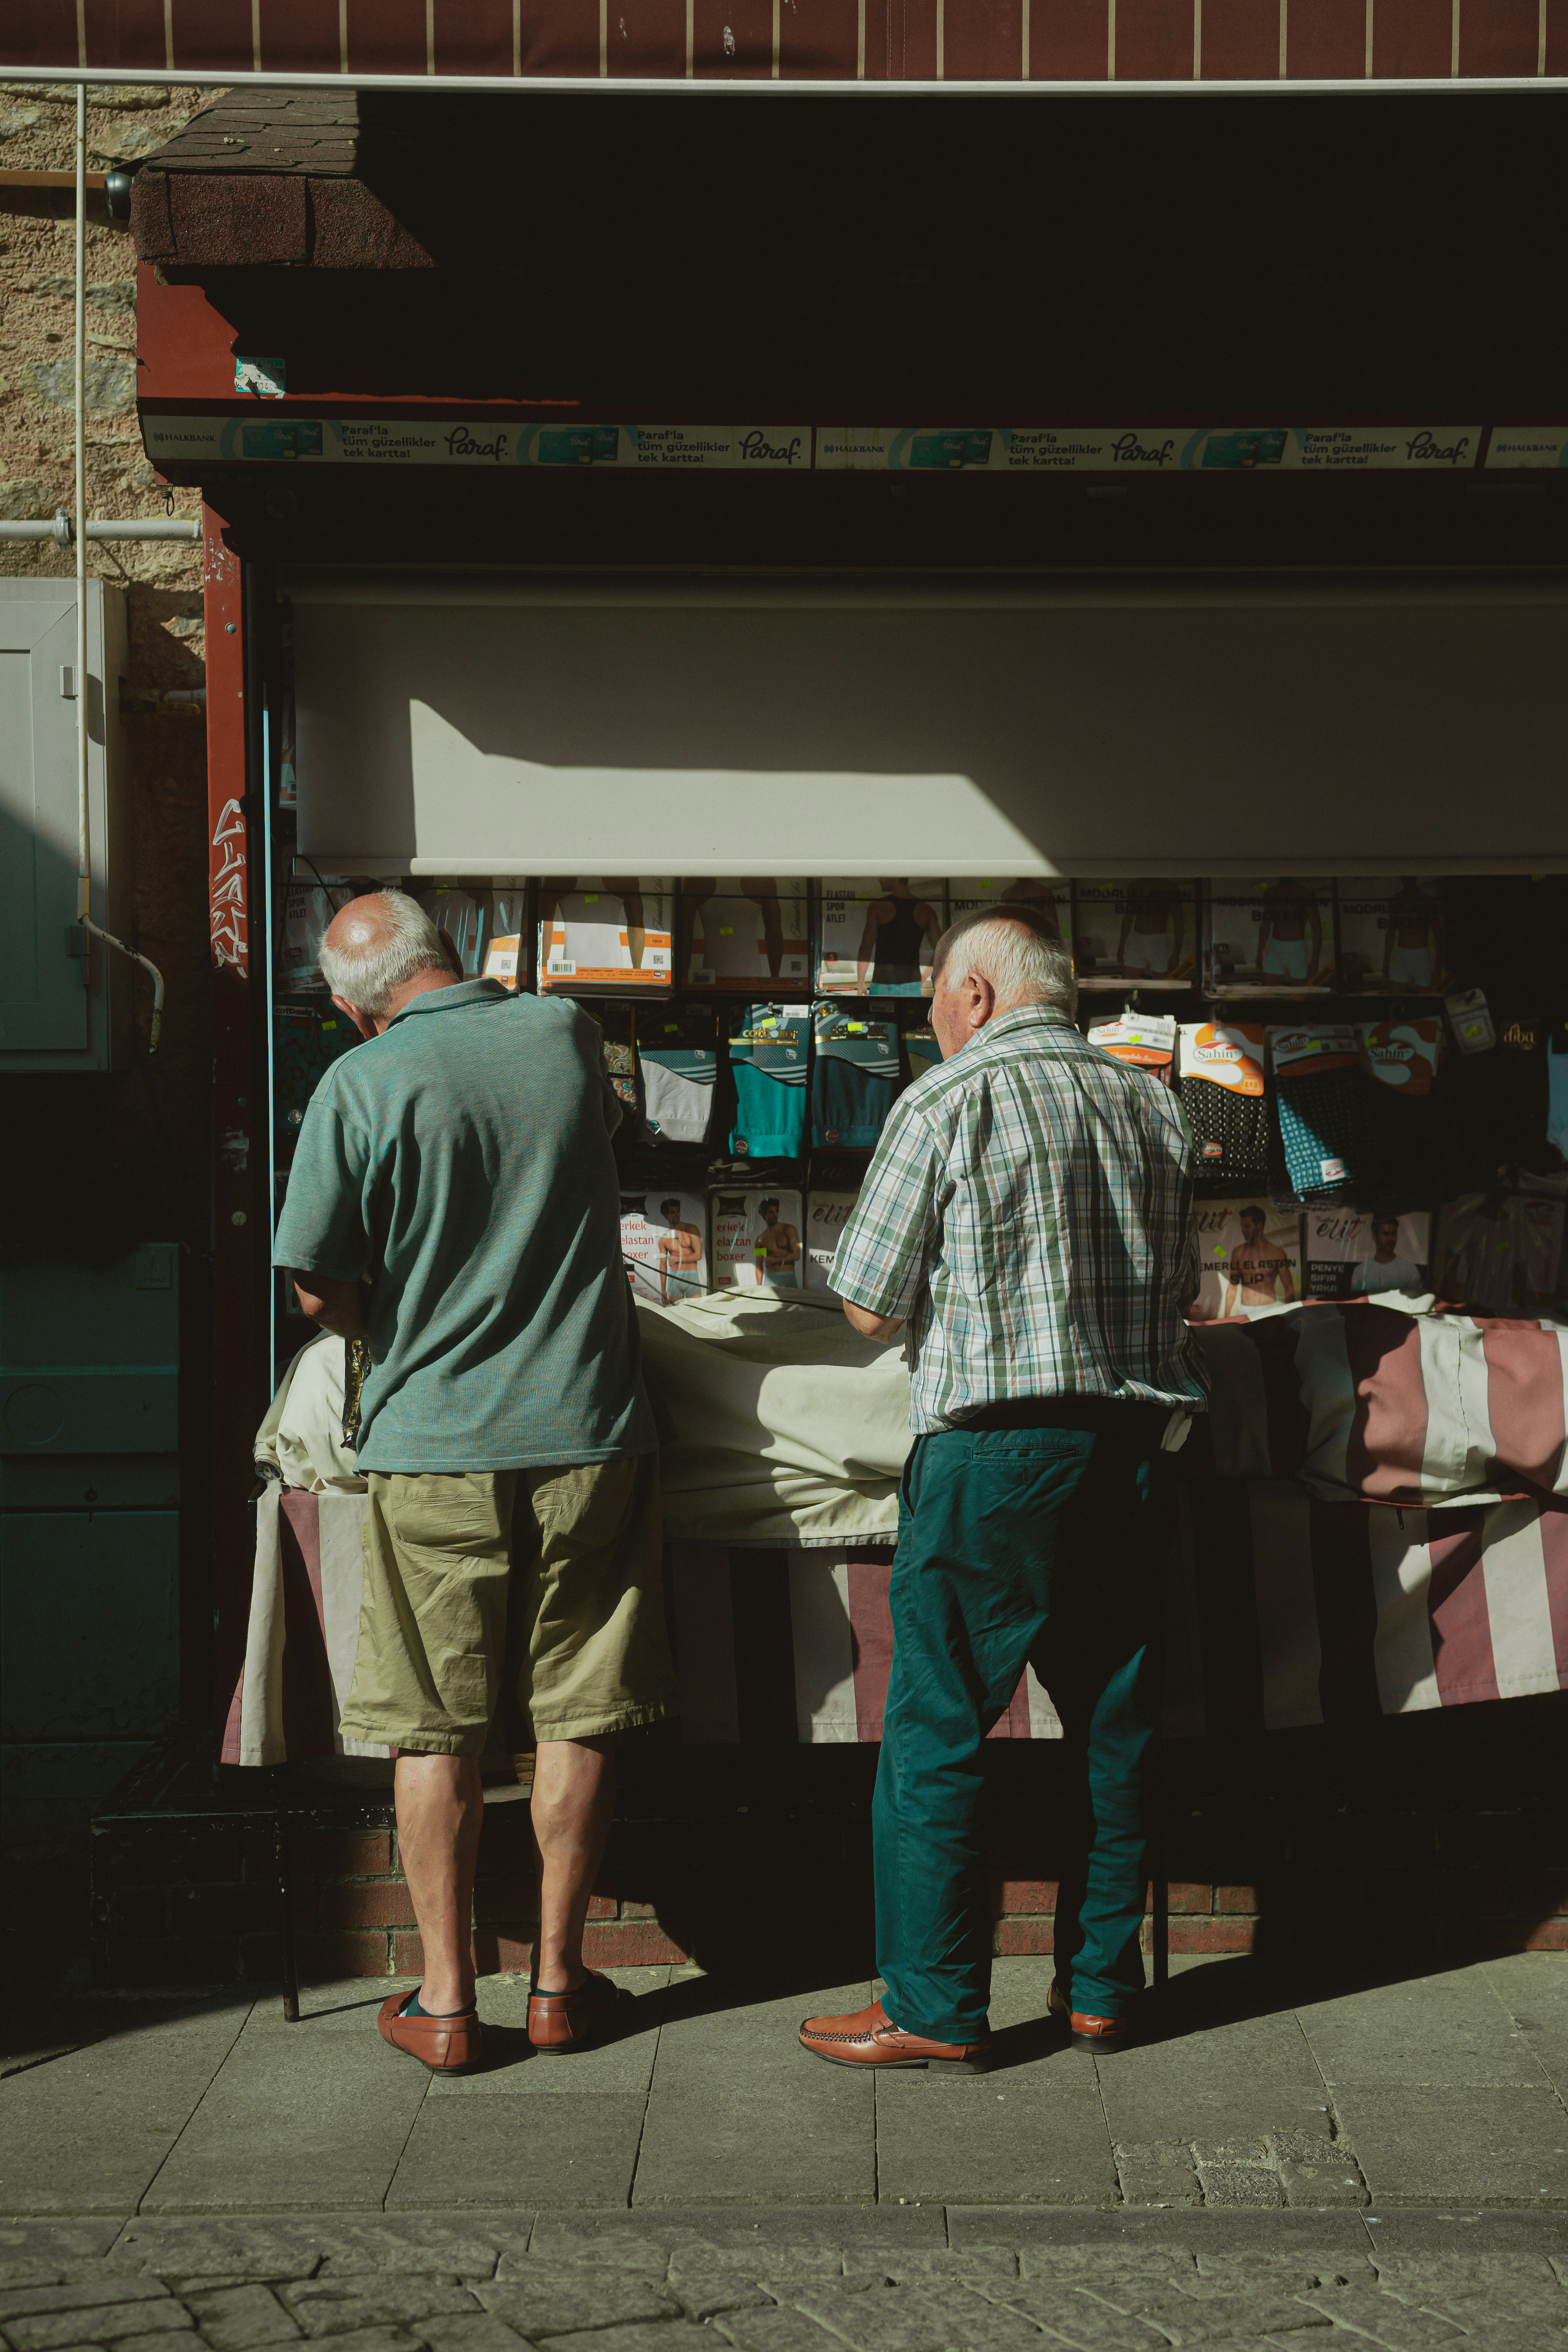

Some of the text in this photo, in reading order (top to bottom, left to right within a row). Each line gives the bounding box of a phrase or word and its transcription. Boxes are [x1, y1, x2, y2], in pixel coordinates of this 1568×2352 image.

[341, 425, 388, 435] Paraf'la
[637, 430, 684, 440] Paraf'la
[165, 434, 216, 442] HALKBANK
[342, 436, 436, 448] tüm güzellikler
[1011, 433, 1057, 443] Paraf'la
[1305, 432, 1352, 442] Paraf'la
[637, 442, 730, 453] tüm güzellikler
[1010, 444, 1103, 456] tüm güzellikler
[1304, 443, 1397, 455] tüm güzellikler
[343, 448, 410, 458] tek kartta!
[637, 453, 704, 463] tek kartta!
[1009, 456, 1075, 465] tek kartta!
[1301, 455, 1368, 464] tek kartta!
[1080, 888, 1128, 898] MODAL
[288, 897, 305, 908] SPOR
[826, 902, 845, 911] SPOR
[289, 909, 307, 920] ATLET
[826, 913, 846, 923] ATLET
[291, 947, 301, 956] XXL
[621, 1220, 646, 1230] erkek
[1198, 1208, 1232, 1232] lit
[717, 1222, 744, 1232] erkek
[621, 1235, 654, 1245] elastan
[717, 1237, 751, 1247] elastan
[717, 1251, 745, 1261] boxer
[1243, 1259, 1296, 1270] ELASTAN
[1311, 1264, 1345, 1272] PENYE
